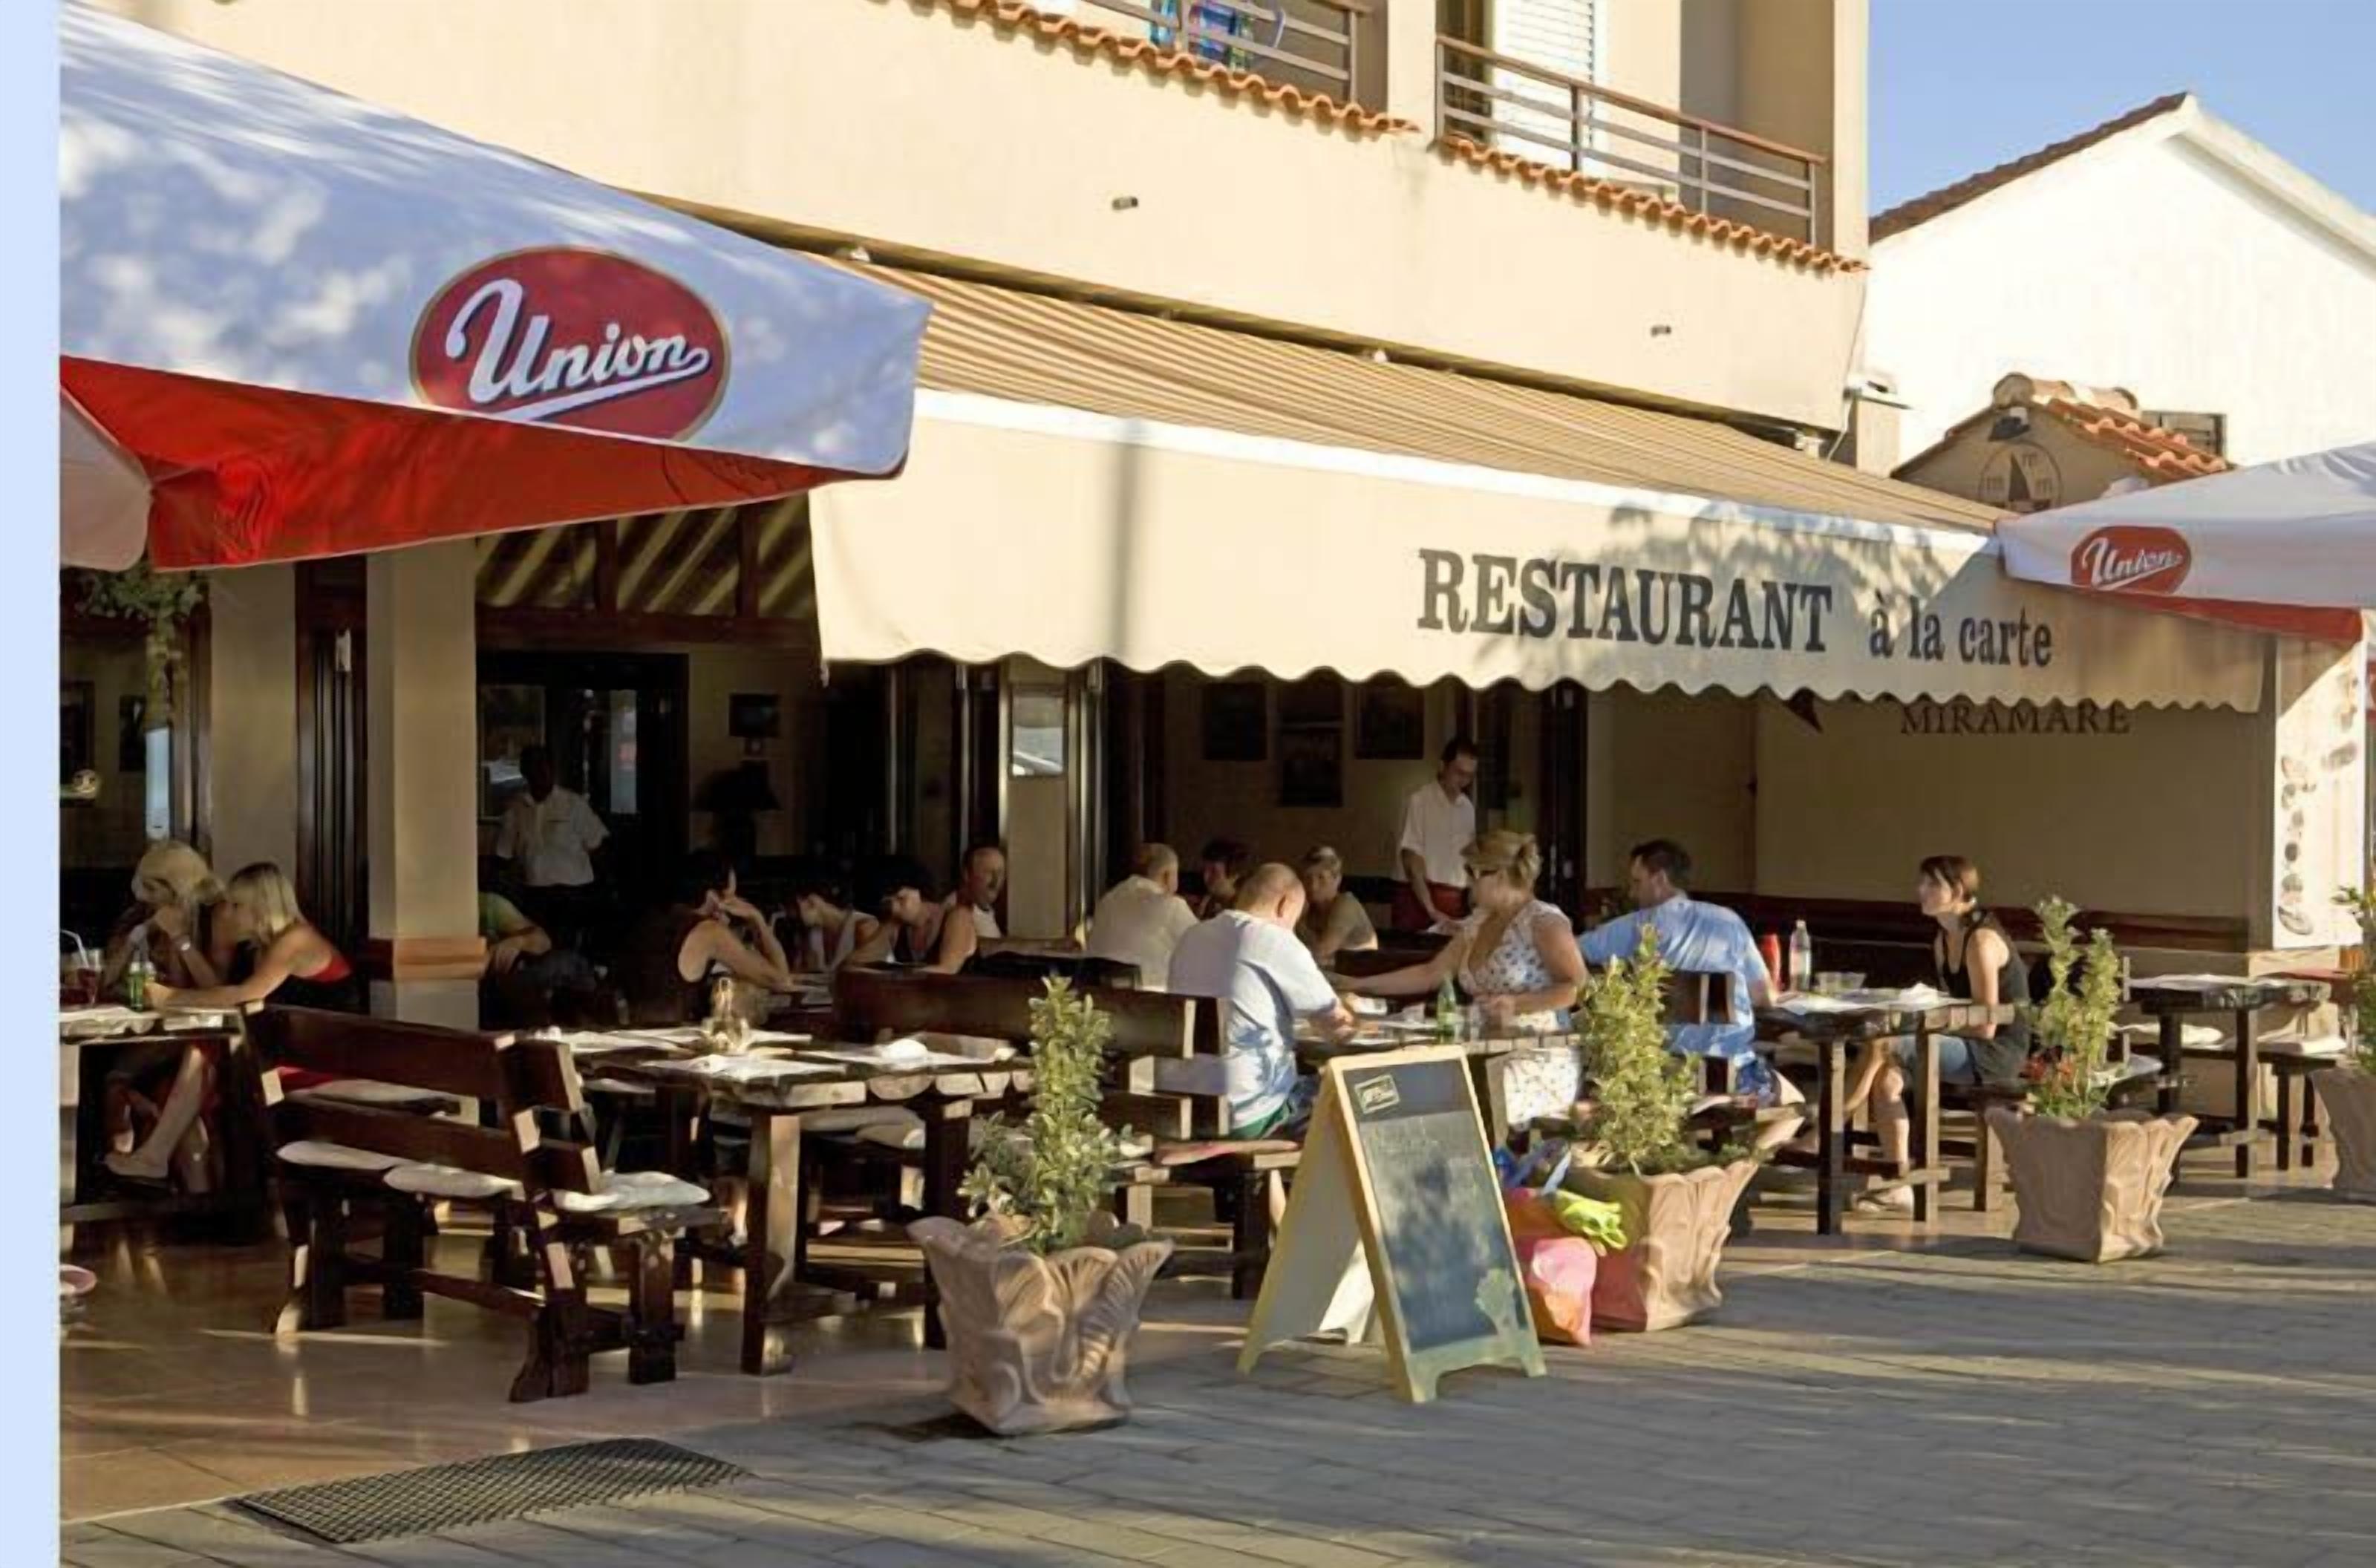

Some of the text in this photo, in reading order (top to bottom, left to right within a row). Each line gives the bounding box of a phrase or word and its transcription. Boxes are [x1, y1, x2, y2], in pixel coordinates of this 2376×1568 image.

[446, 278, 710, 421] Union
[1417, 549, 2051, 666] RESTAURANT à la carte
[1900, 699, 2130, 734] MIRAMARE
